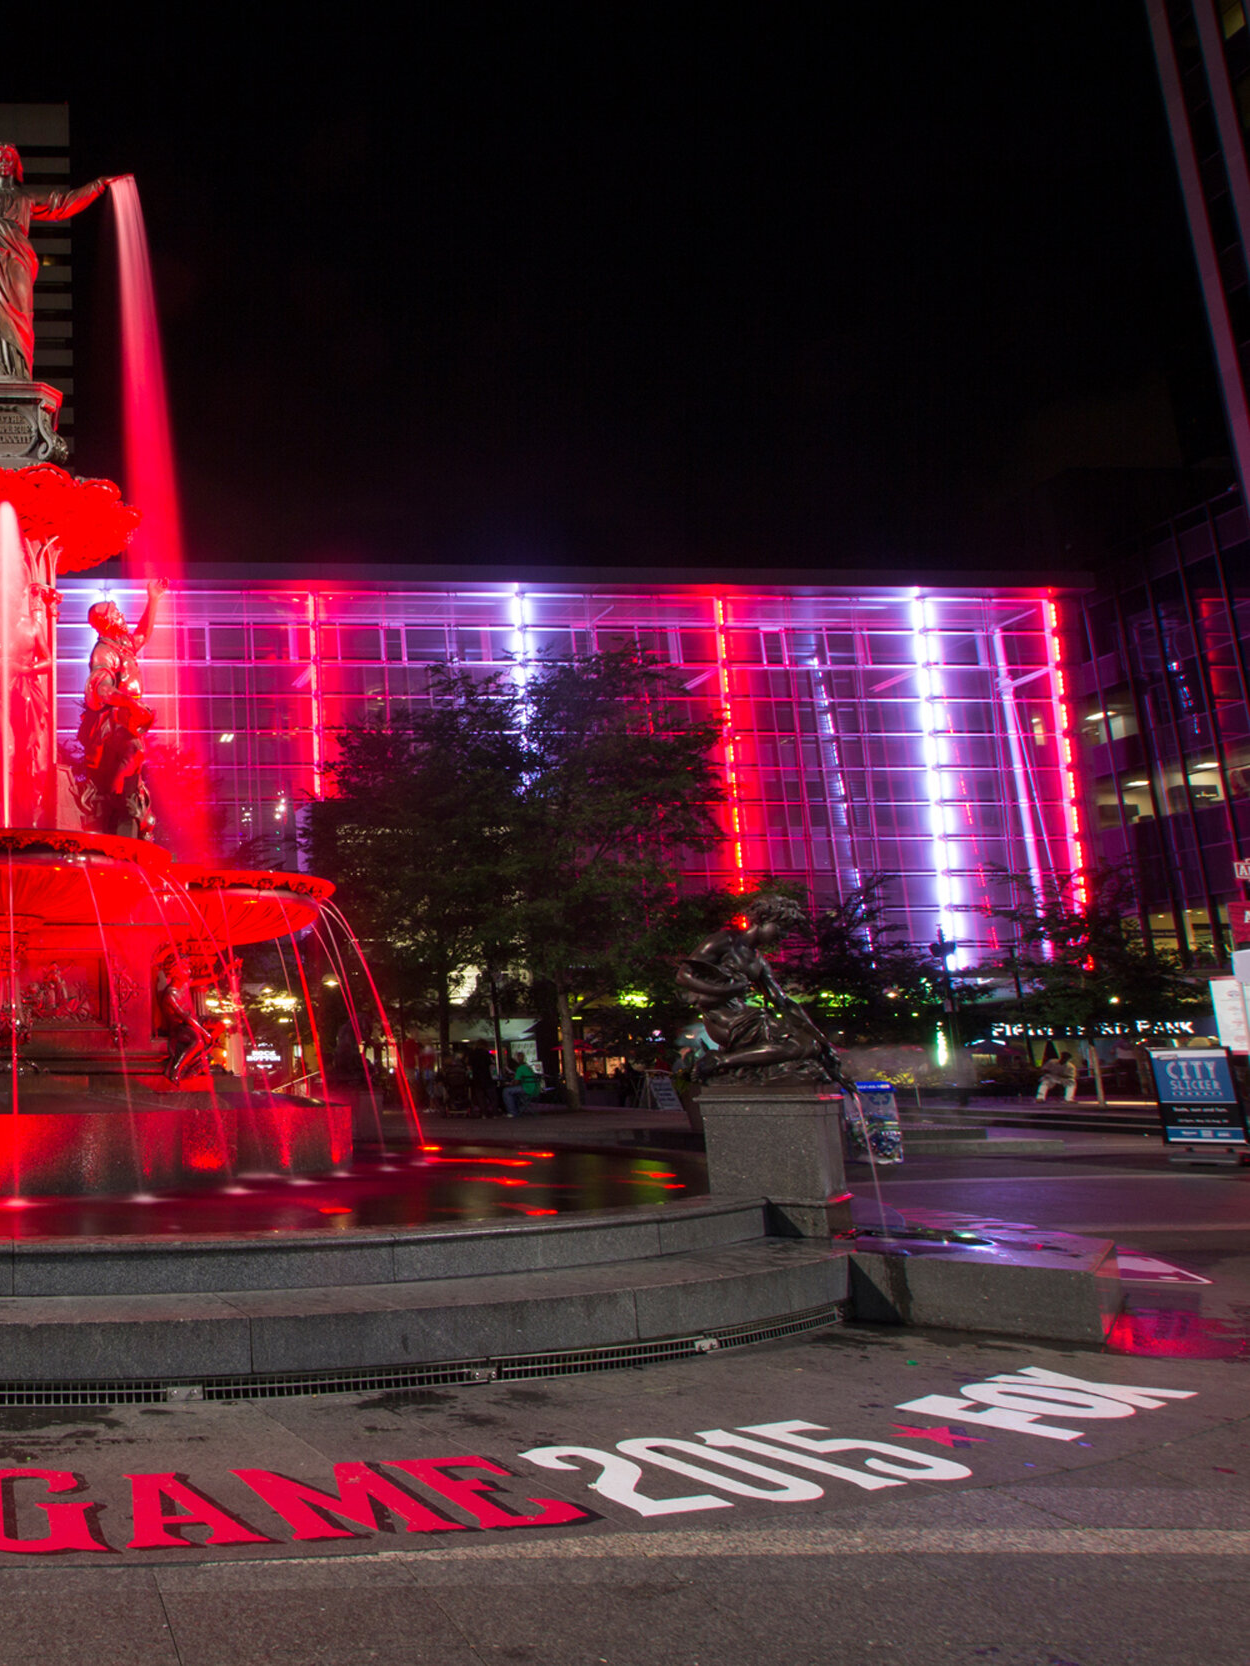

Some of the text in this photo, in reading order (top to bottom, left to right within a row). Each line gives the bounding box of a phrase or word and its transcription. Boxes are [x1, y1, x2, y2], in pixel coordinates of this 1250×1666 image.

[1166, 1061, 1216, 1079] CITY
[1170, 1079, 1221, 1091] SLICKER
[518, 1419, 972, 1517] 2015
[894, 1366, 1198, 1441] FOX
